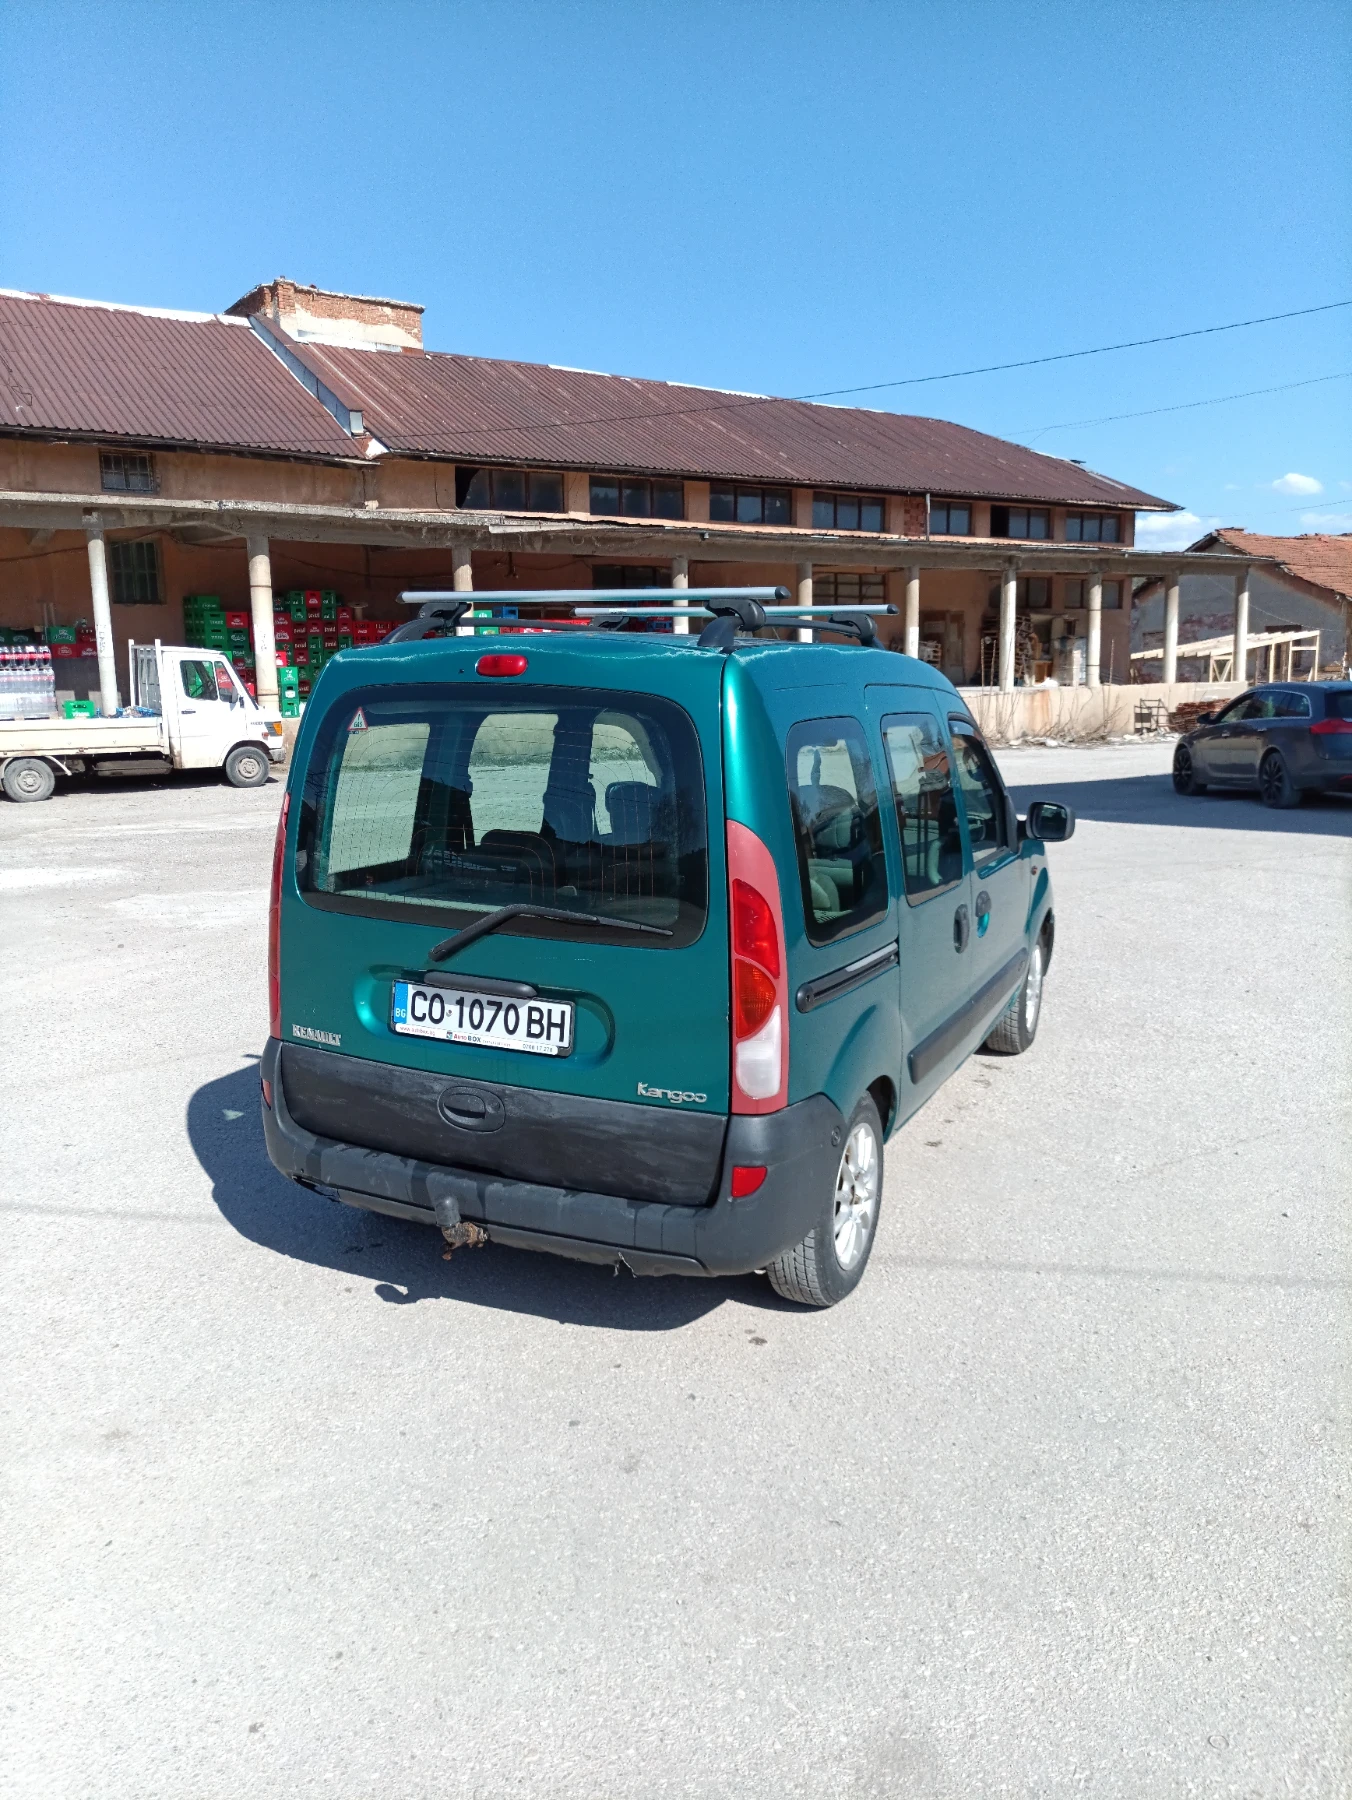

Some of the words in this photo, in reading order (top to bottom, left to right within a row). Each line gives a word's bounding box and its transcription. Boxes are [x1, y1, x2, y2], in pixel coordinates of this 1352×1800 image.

[395, 1007, 406, 1018] BG
[455, 996, 520, 1036] 1070
[526, 1005, 566, 1042] BH
[292, 1024, 341, 1046] RENAULT
[637, 1081, 707, 1104] Kangoo
